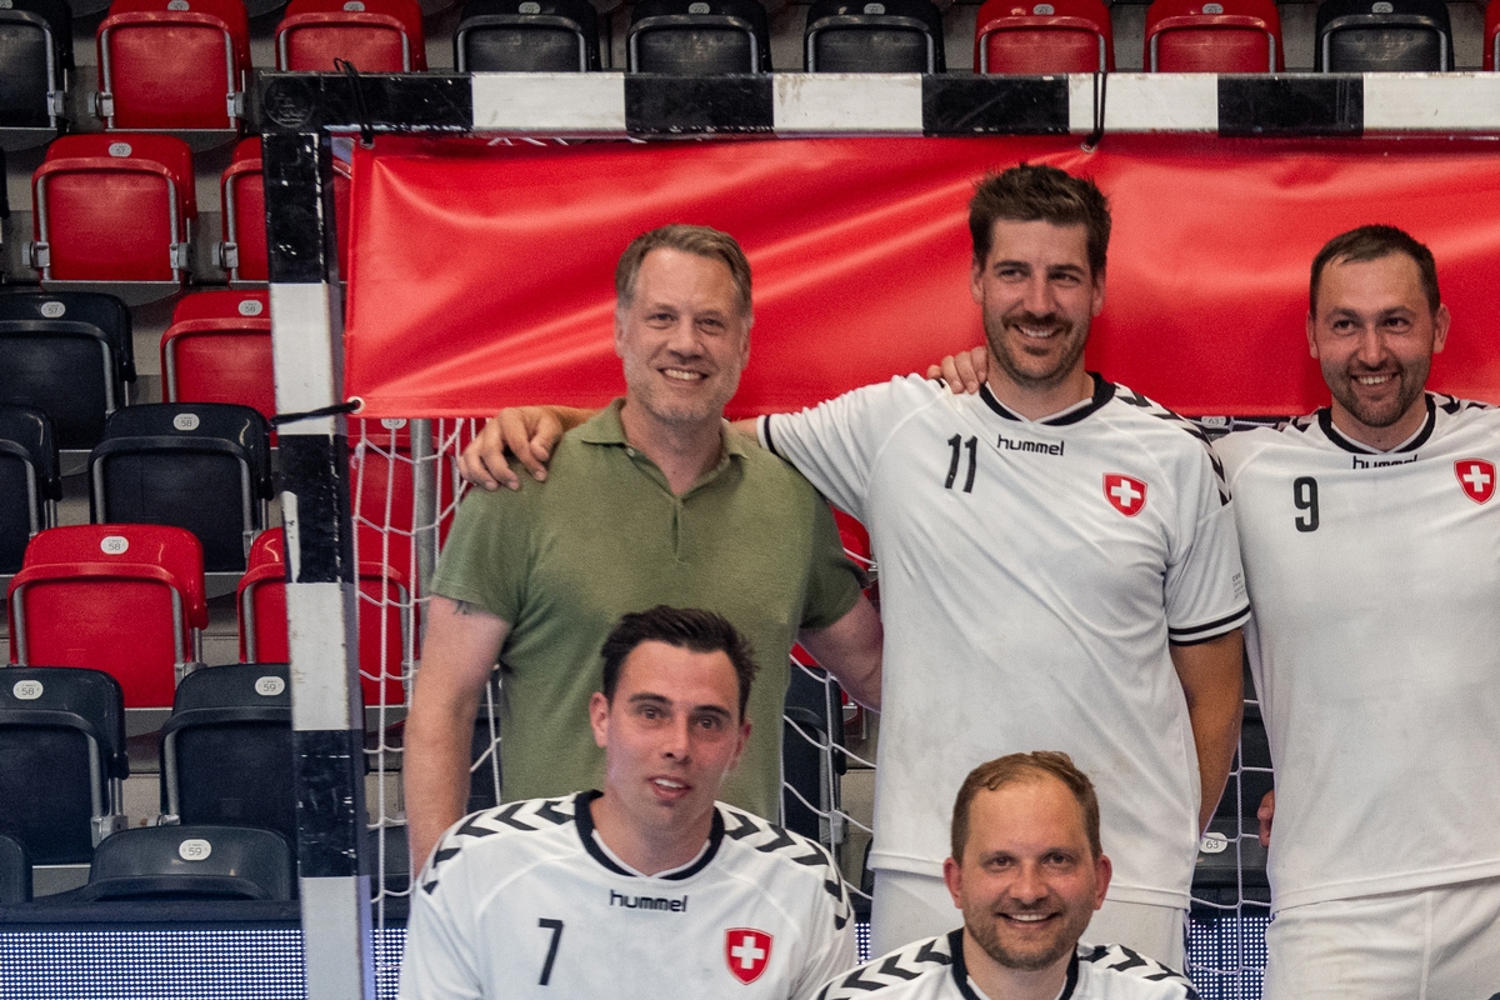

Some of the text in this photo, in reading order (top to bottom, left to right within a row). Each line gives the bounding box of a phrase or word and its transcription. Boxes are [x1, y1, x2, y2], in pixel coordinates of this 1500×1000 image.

[48, 307, 59, 315] 57
[997, 434, 1065, 456] hummel
[944, 434, 978, 494] 11
[1293, 476, 1320, 533] 9
[108, 543, 120, 551] 58
[21, 688, 34, 696] 58
[263, 684, 276, 692] 59
[1205, 839, 1220, 849] 63
[188, 847, 202, 856] 59
[610, 890, 688, 912] hummel
[538, 918, 564, 986] 7
